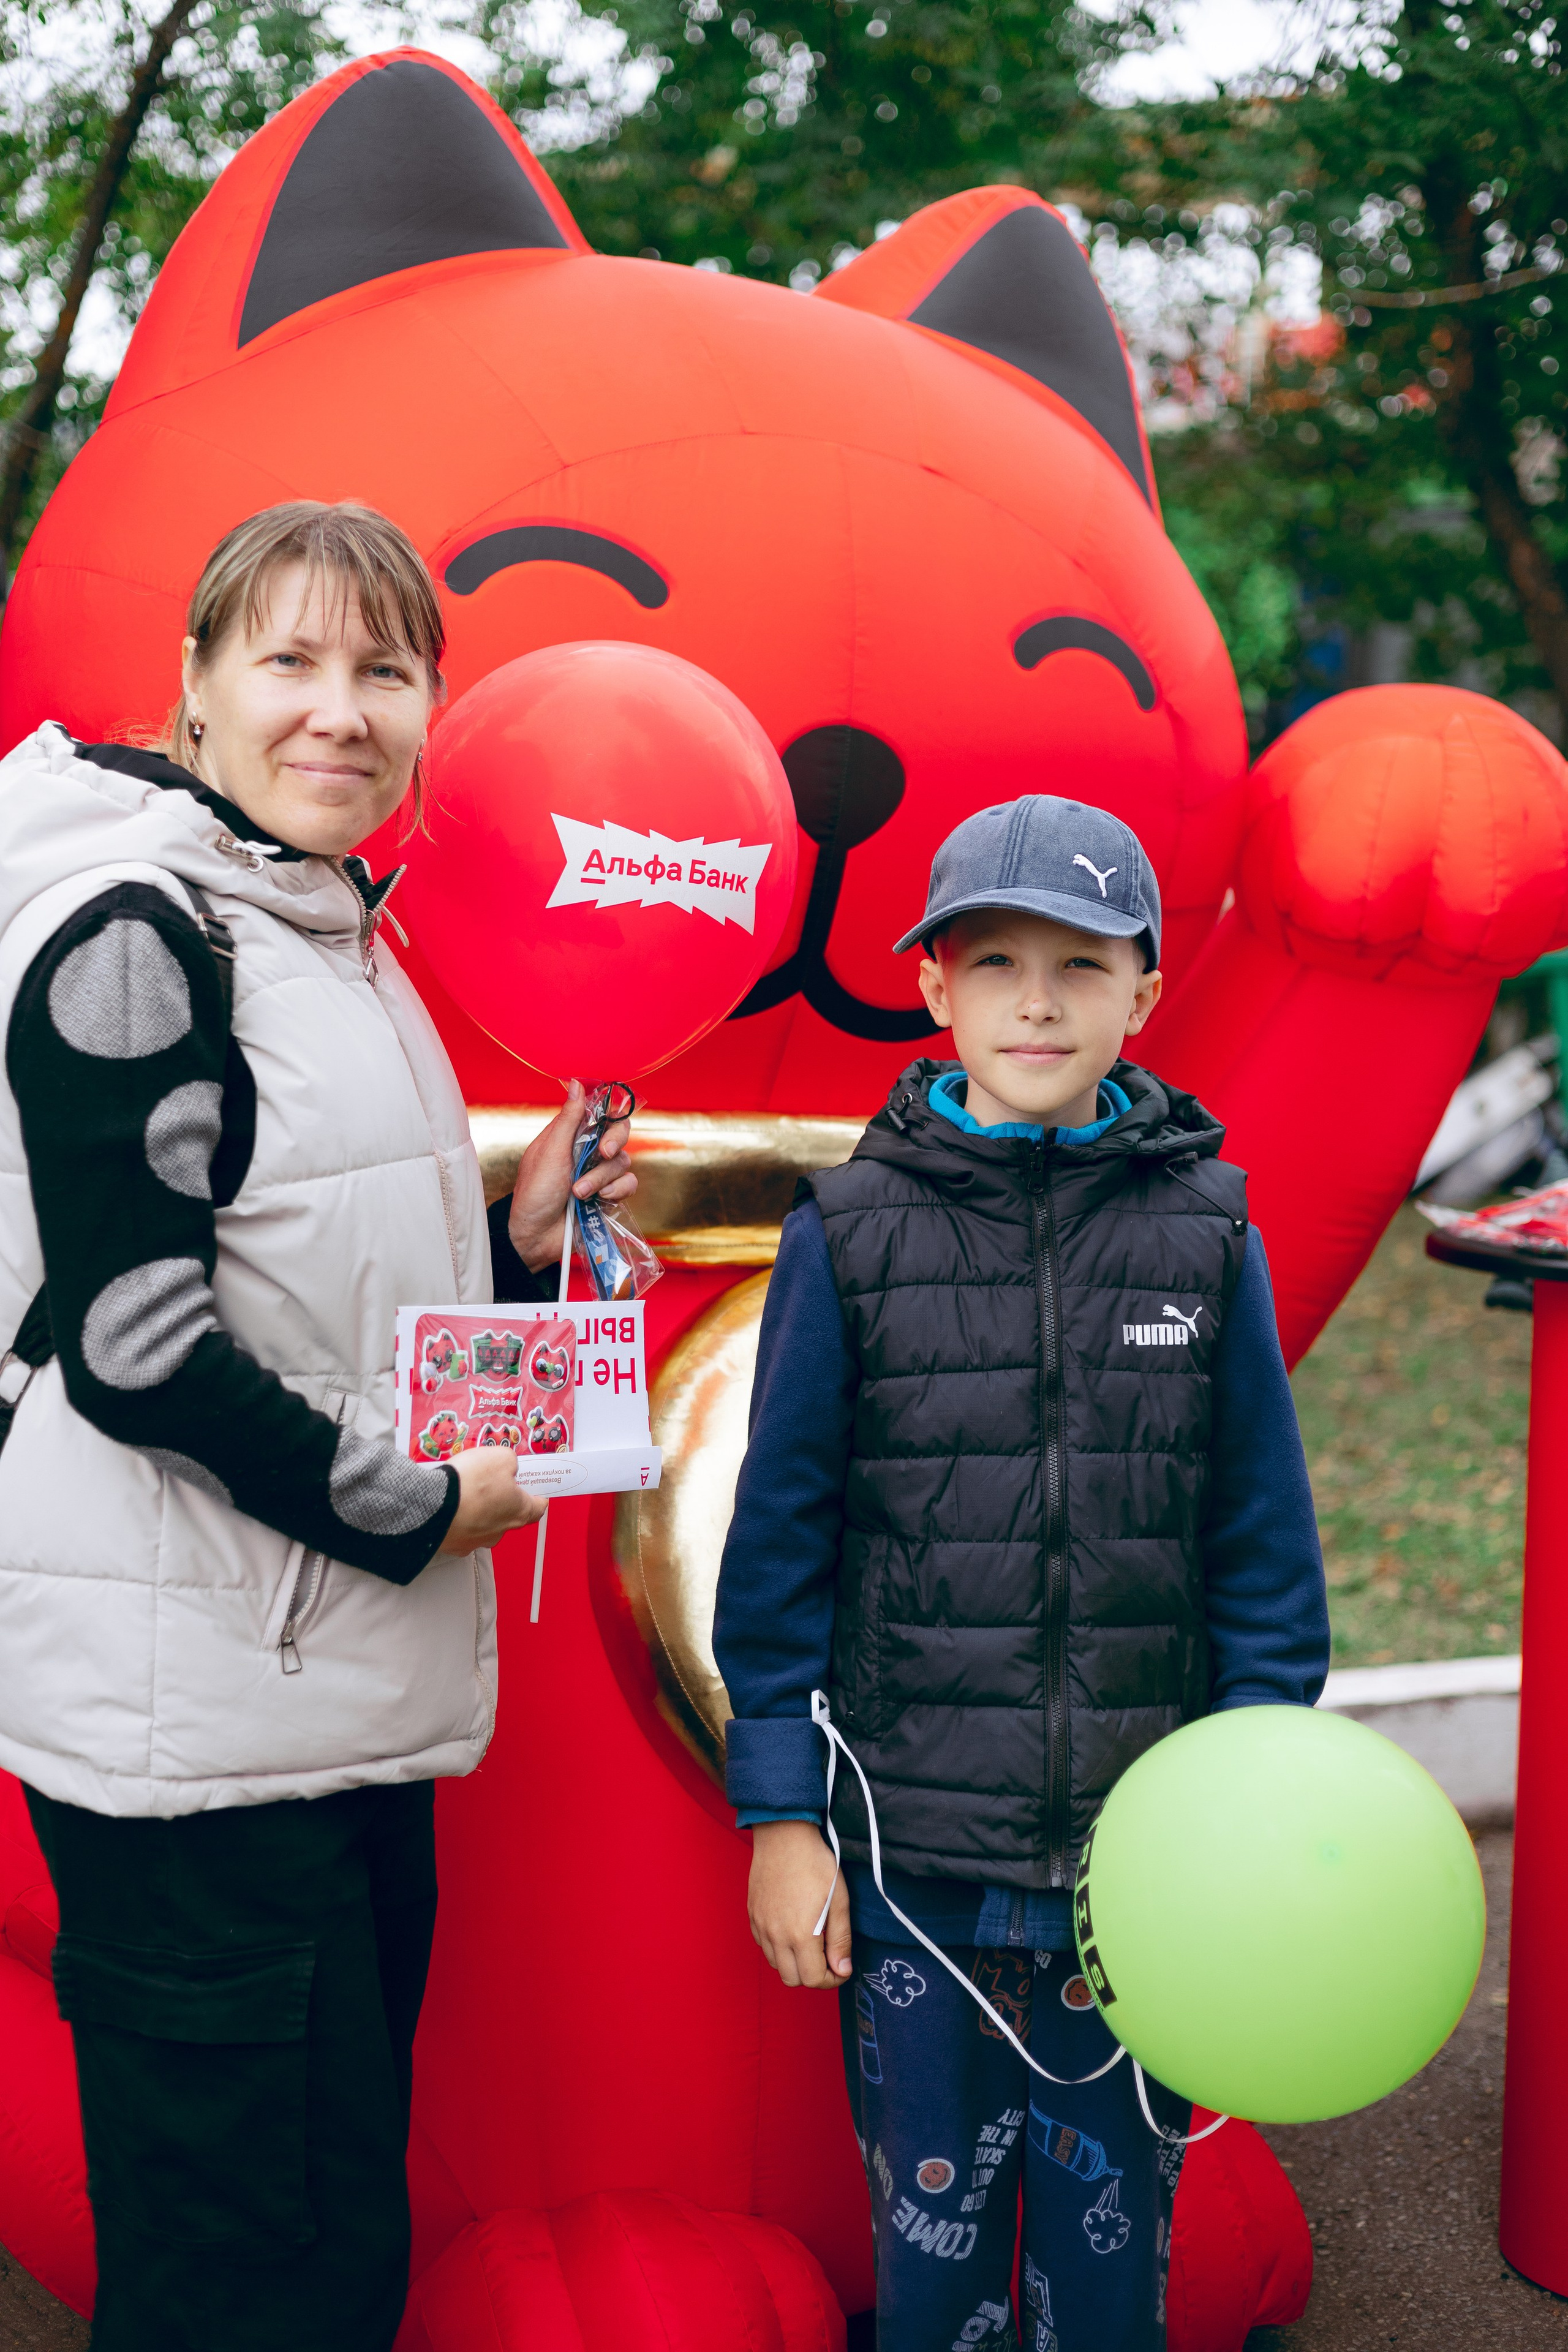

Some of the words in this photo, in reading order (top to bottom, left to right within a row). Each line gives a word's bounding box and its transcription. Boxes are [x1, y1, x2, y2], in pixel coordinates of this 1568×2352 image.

[581, 849, 682, 885] Альфа
[688, 859, 749, 894] Банк
[1123, 1324, 1188, 1346] PUMA
[478, 1396, 500, 1408] Альфа
[501, 1397, 516, 1407] Банк
[997, 2108, 1026, 2127] CITY
[978, 2125, 1001, 2143] THE
[1000, 2129, 1018, 2147] IN
[974, 2147, 1006, 2165] SKATE
[960, 2193, 975, 2212] GO
[892, 2196, 978, 2260] COME
